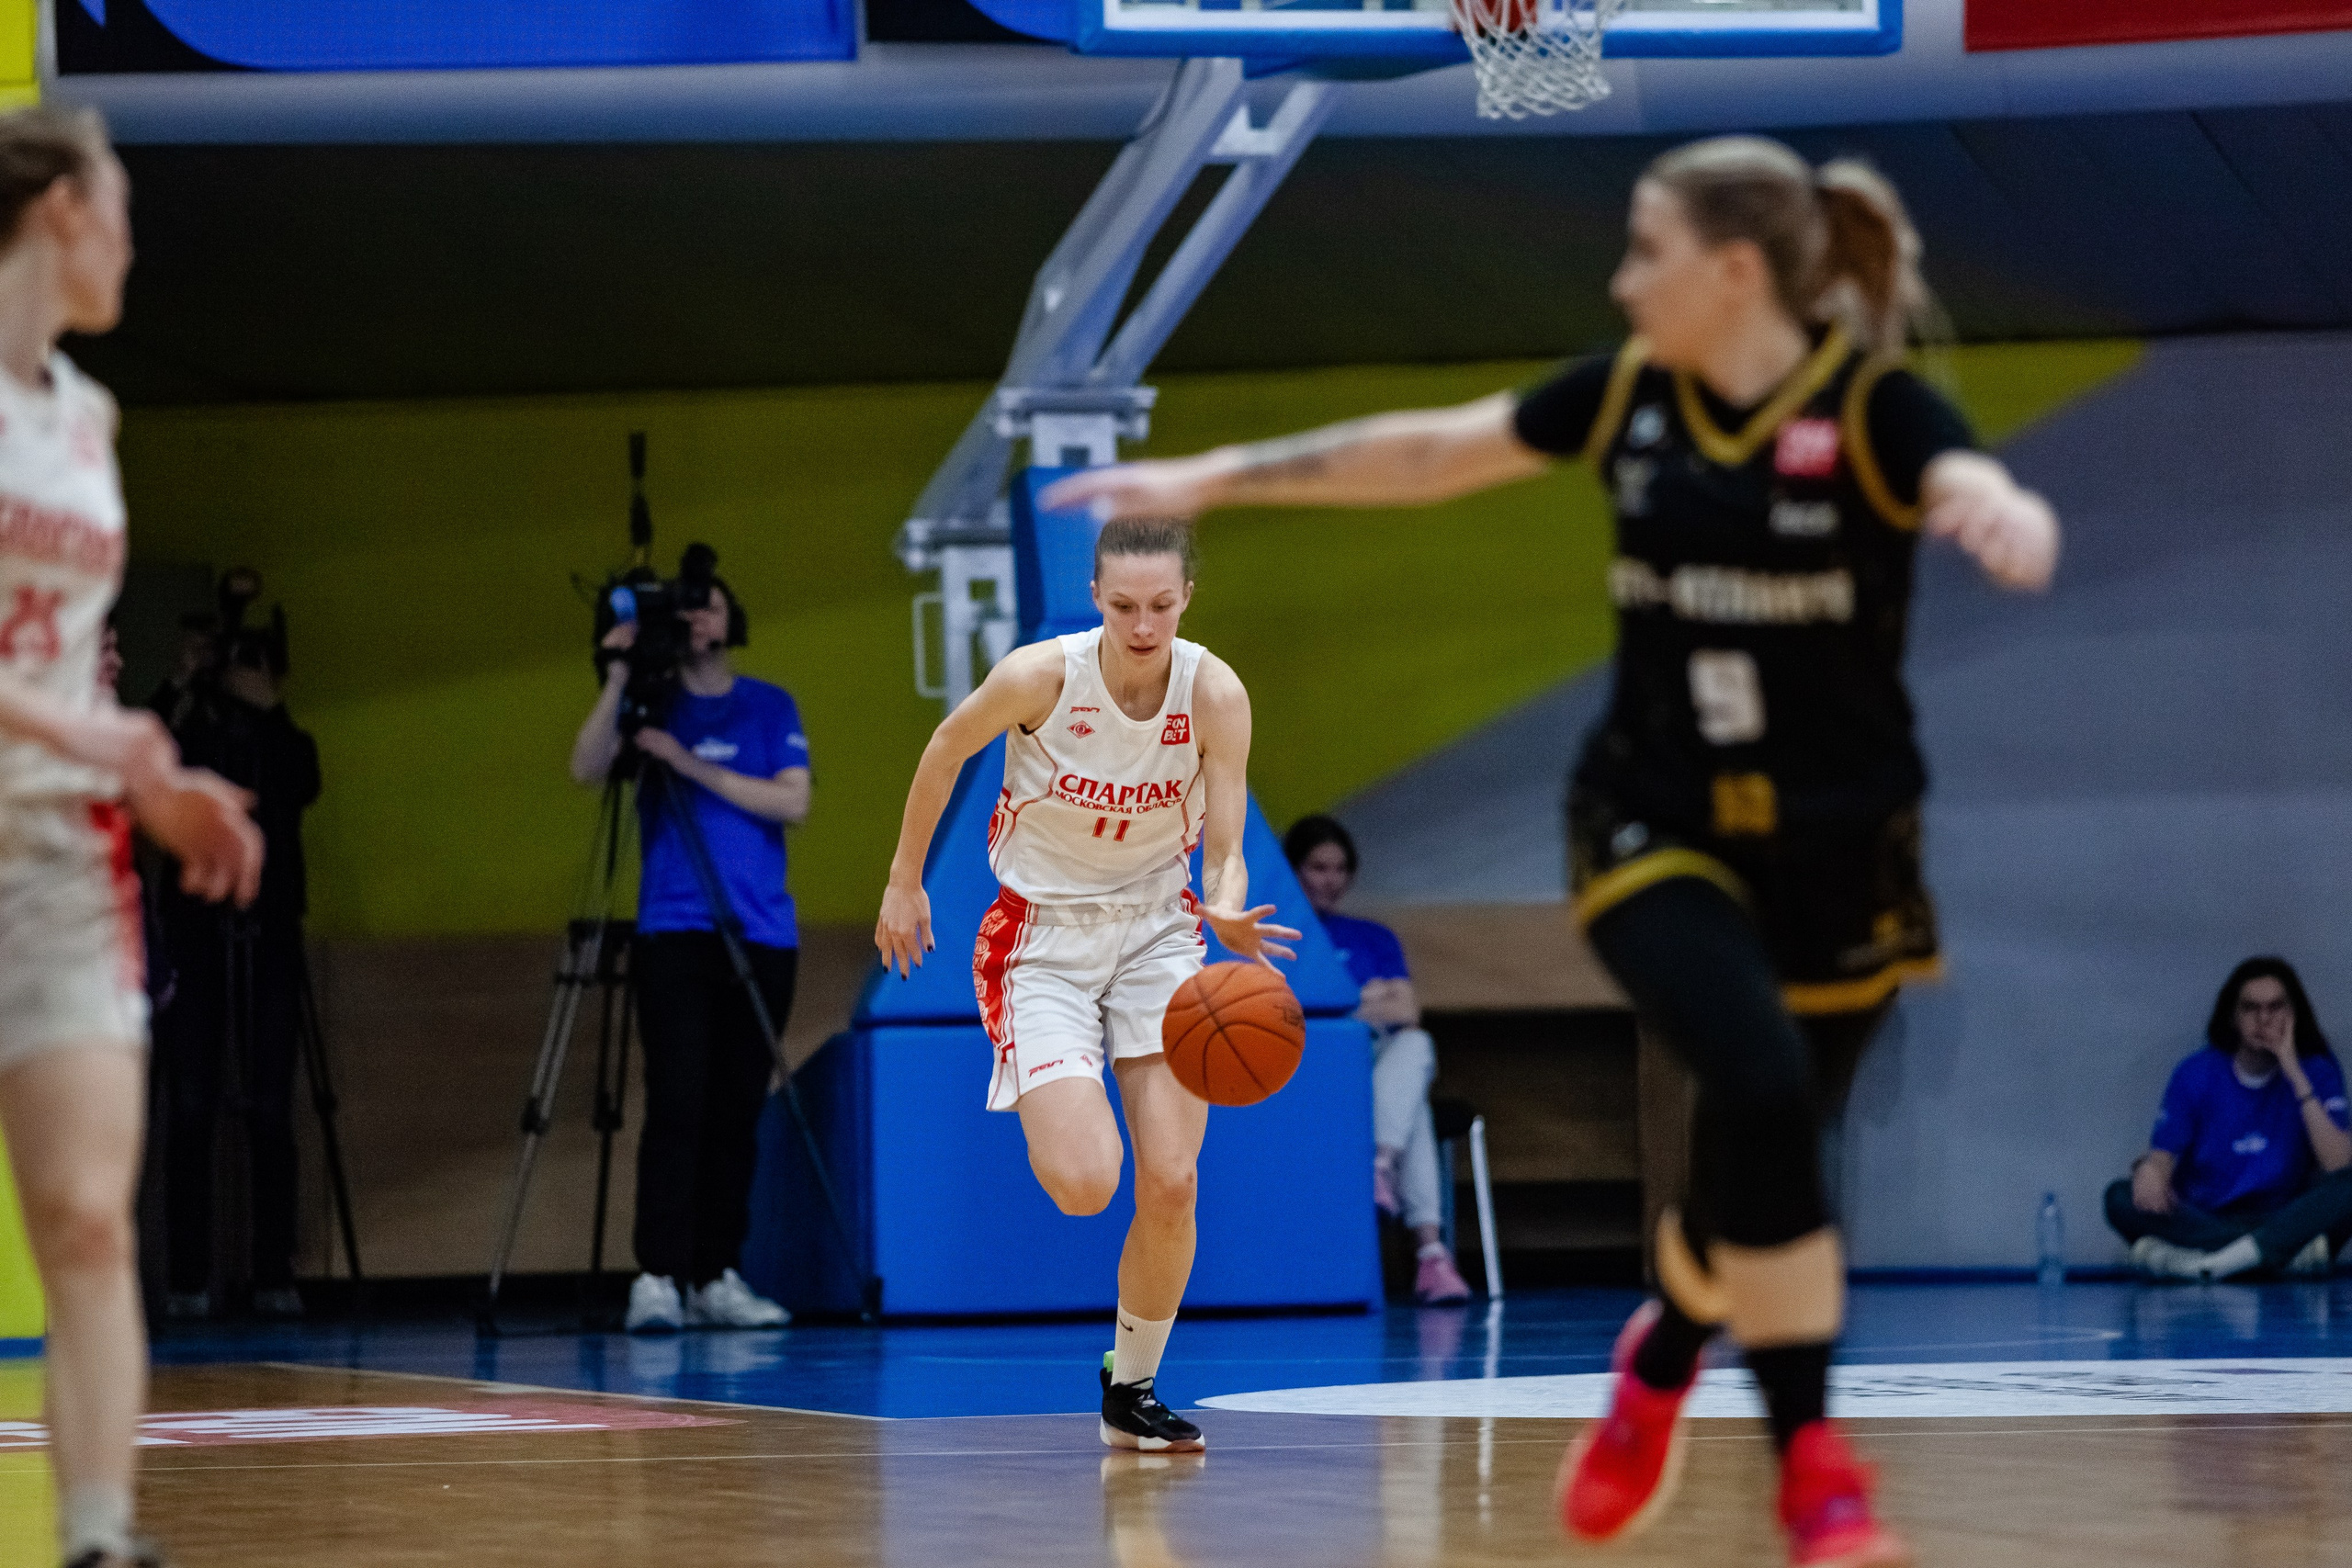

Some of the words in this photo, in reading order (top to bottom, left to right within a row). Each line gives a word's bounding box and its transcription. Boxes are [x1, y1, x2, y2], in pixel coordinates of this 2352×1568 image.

[1055, 790, 1133, 814] МОСКОВСКАЯ
[1136, 798, 1182, 814] ОБЛАСТЬ
[1058, 773, 1183, 806] СПАРТАК
[1091, 817, 1131, 842] 11
